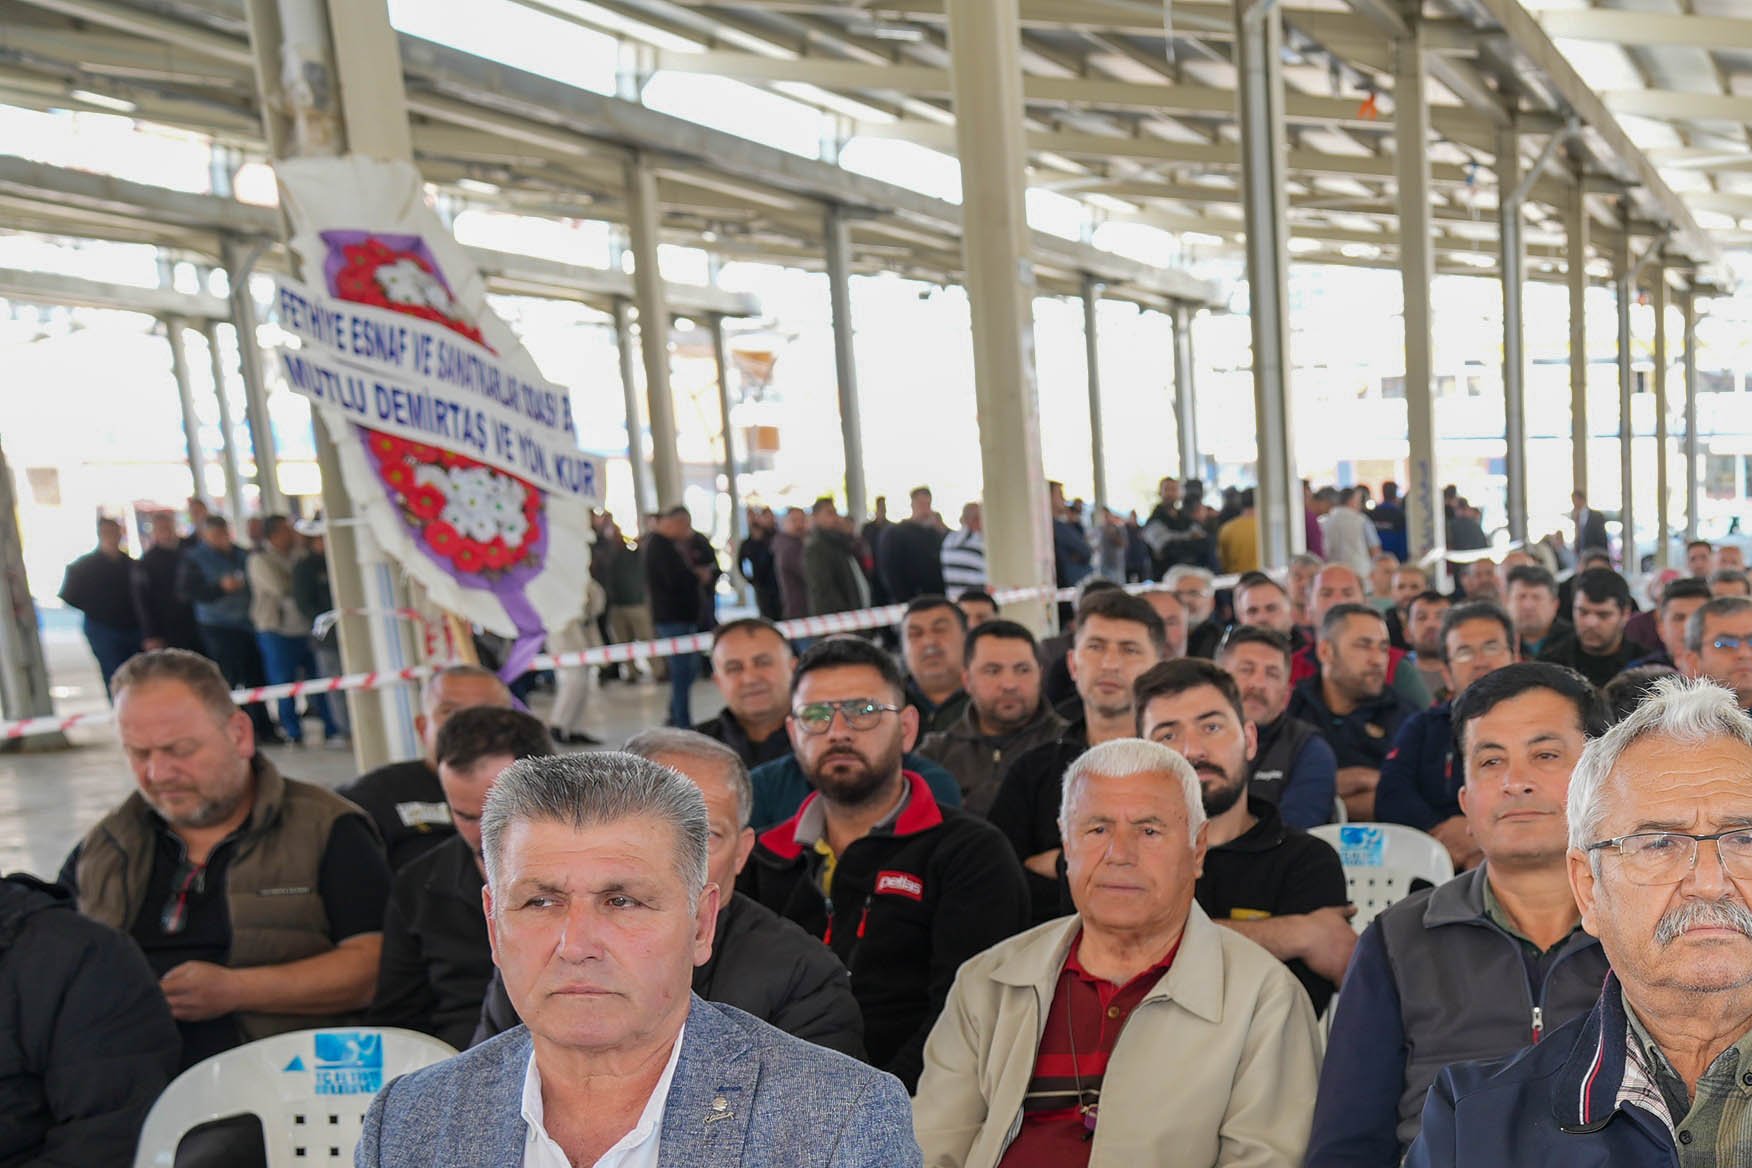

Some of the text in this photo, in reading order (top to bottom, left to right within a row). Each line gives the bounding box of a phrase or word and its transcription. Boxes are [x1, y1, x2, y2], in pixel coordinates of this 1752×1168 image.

[352, 315, 407, 367] ESNAF
[411, 331, 432, 376] VE
[284, 353, 367, 415] MUTLU
[374, 383, 487, 456] DEMİRTAŞ
[493, 414, 515, 463] VE
[554, 453, 597, 497] KUR
